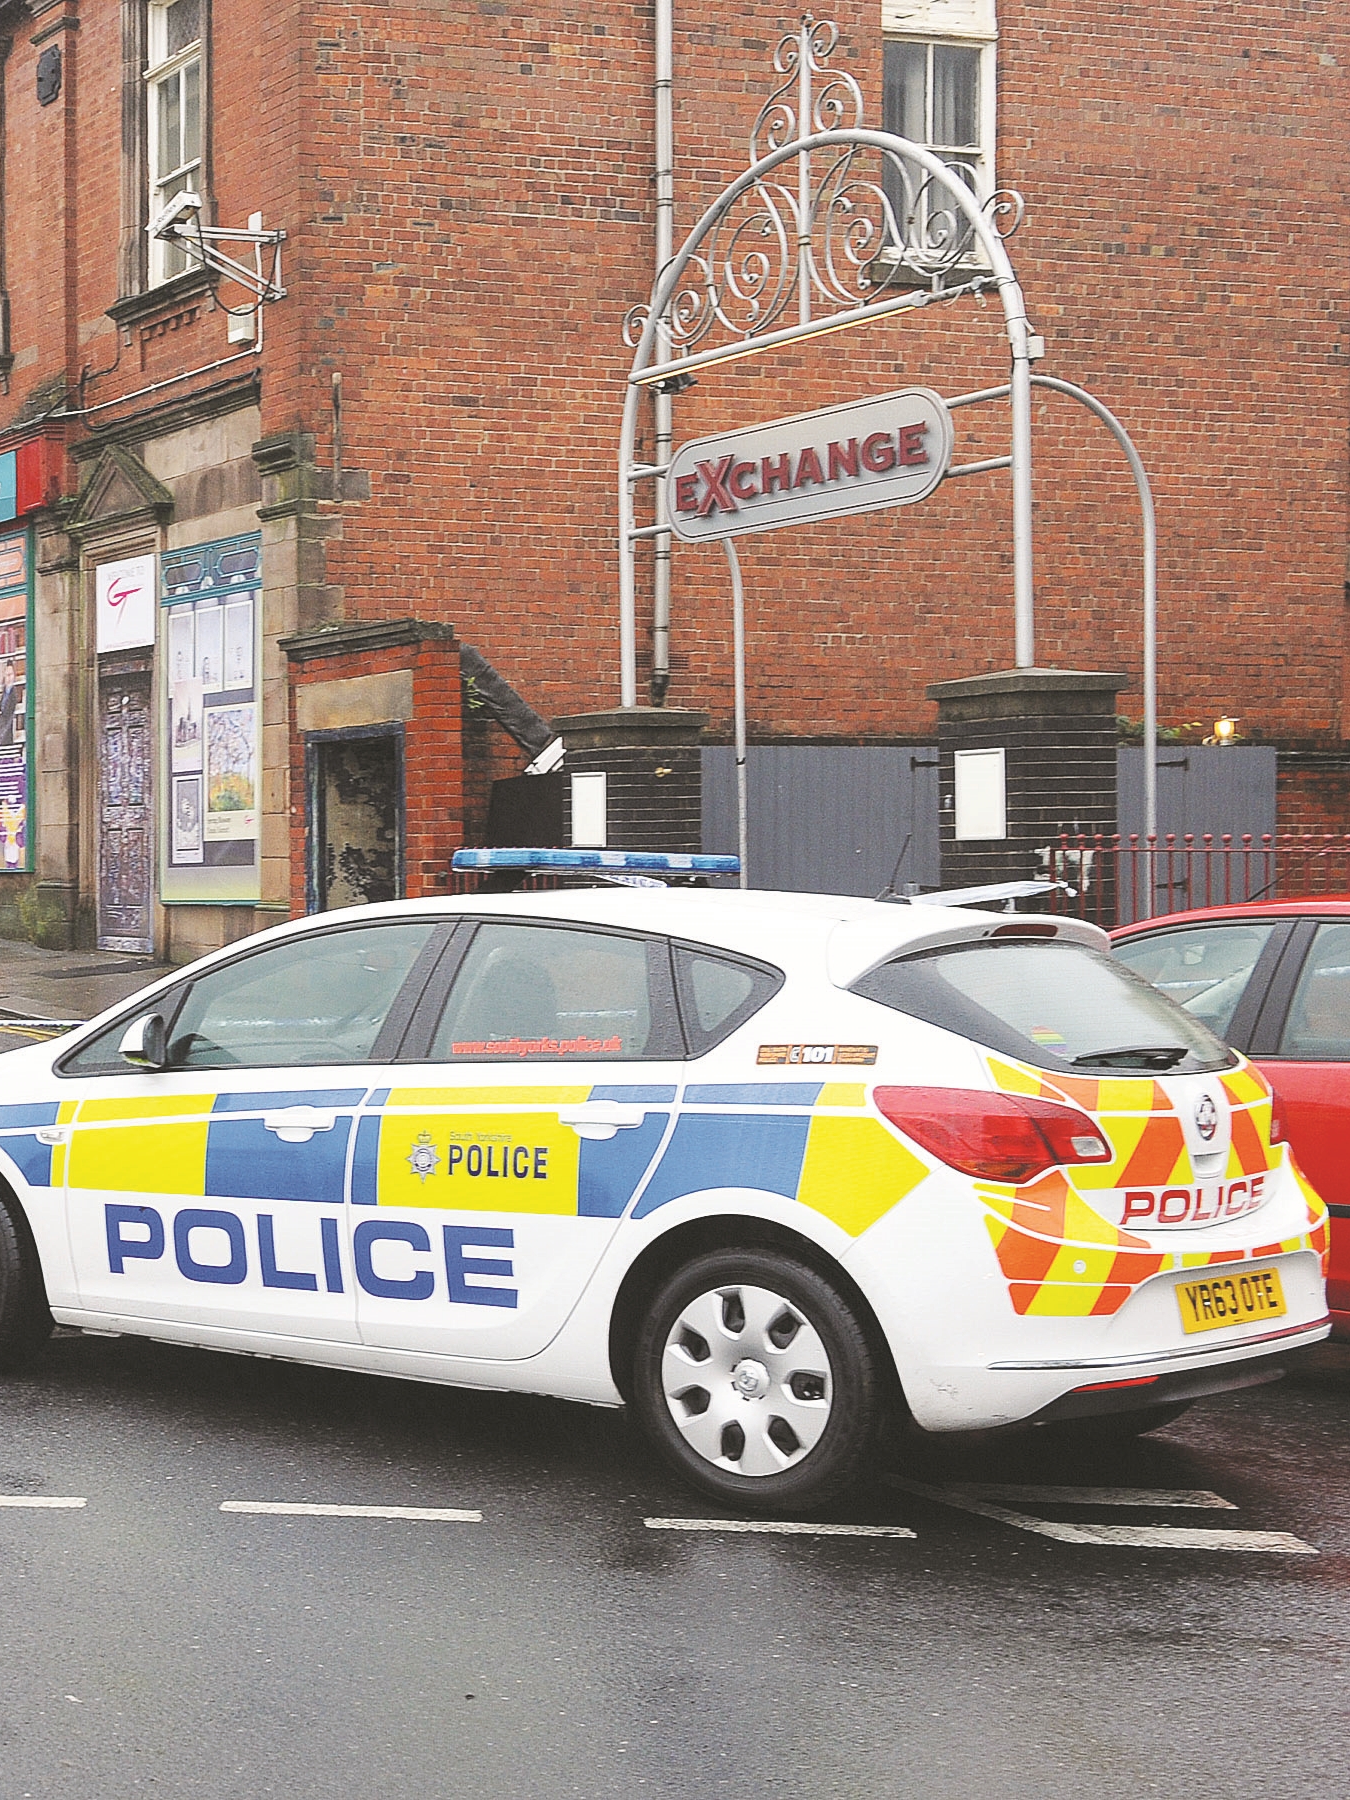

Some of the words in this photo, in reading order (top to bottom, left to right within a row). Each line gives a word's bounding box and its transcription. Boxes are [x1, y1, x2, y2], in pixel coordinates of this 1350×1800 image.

[675, 420, 929, 518] EXCHANGE
[802, 1046, 835, 1063] 101
[448, 1144, 548, 1179] POLICE
[1119, 1175, 1265, 1226] POLICE
[104, 1203, 519, 1309] POLICE
[1185, 1280, 1239, 1322] YR63
[1239, 1273, 1278, 1312] OTE
